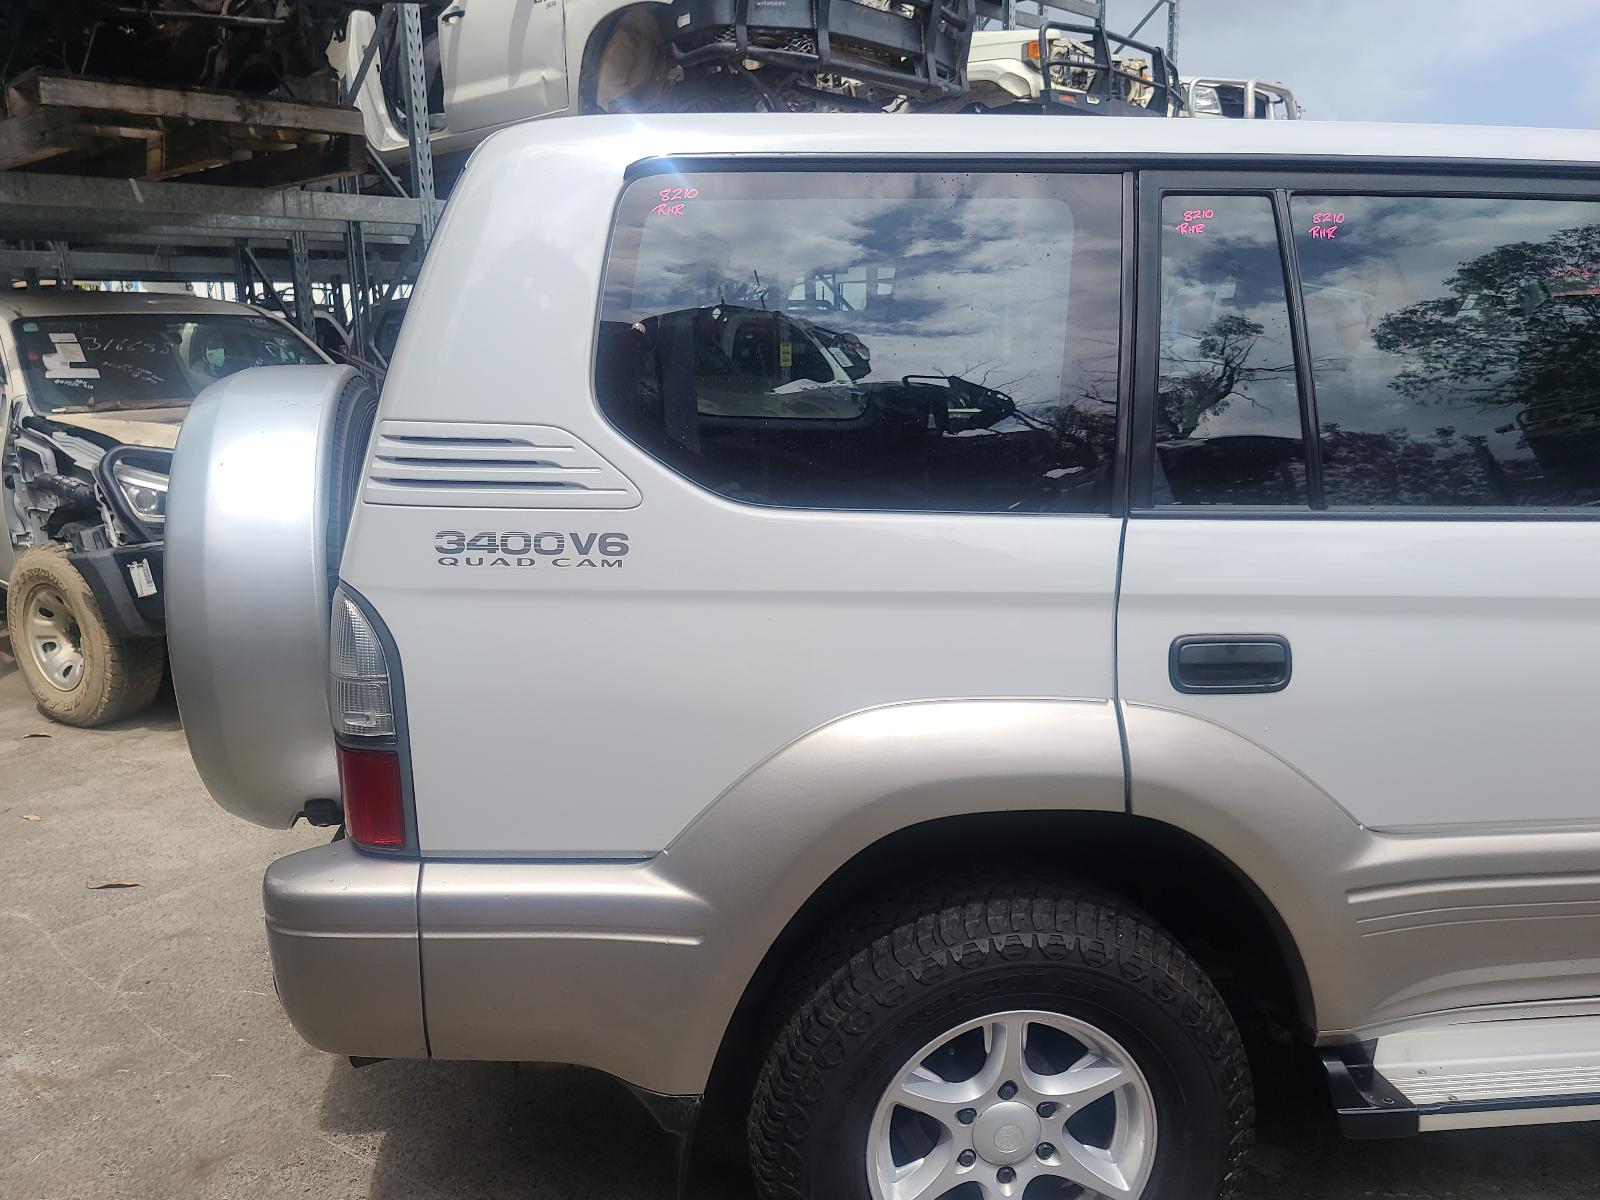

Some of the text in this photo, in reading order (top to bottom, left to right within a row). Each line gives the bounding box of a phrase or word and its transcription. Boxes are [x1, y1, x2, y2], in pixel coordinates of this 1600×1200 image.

[658, 188, 698, 201] 8210
[651, 203, 686, 216] RHR
[1183, 210, 1214, 222] 8210
[1312, 212, 1345, 224] 8210
[1176, 223, 1206, 235] RHR
[1308, 225, 1338, 239] RHR
[437, 557, 623, 568] QUAD CAM
